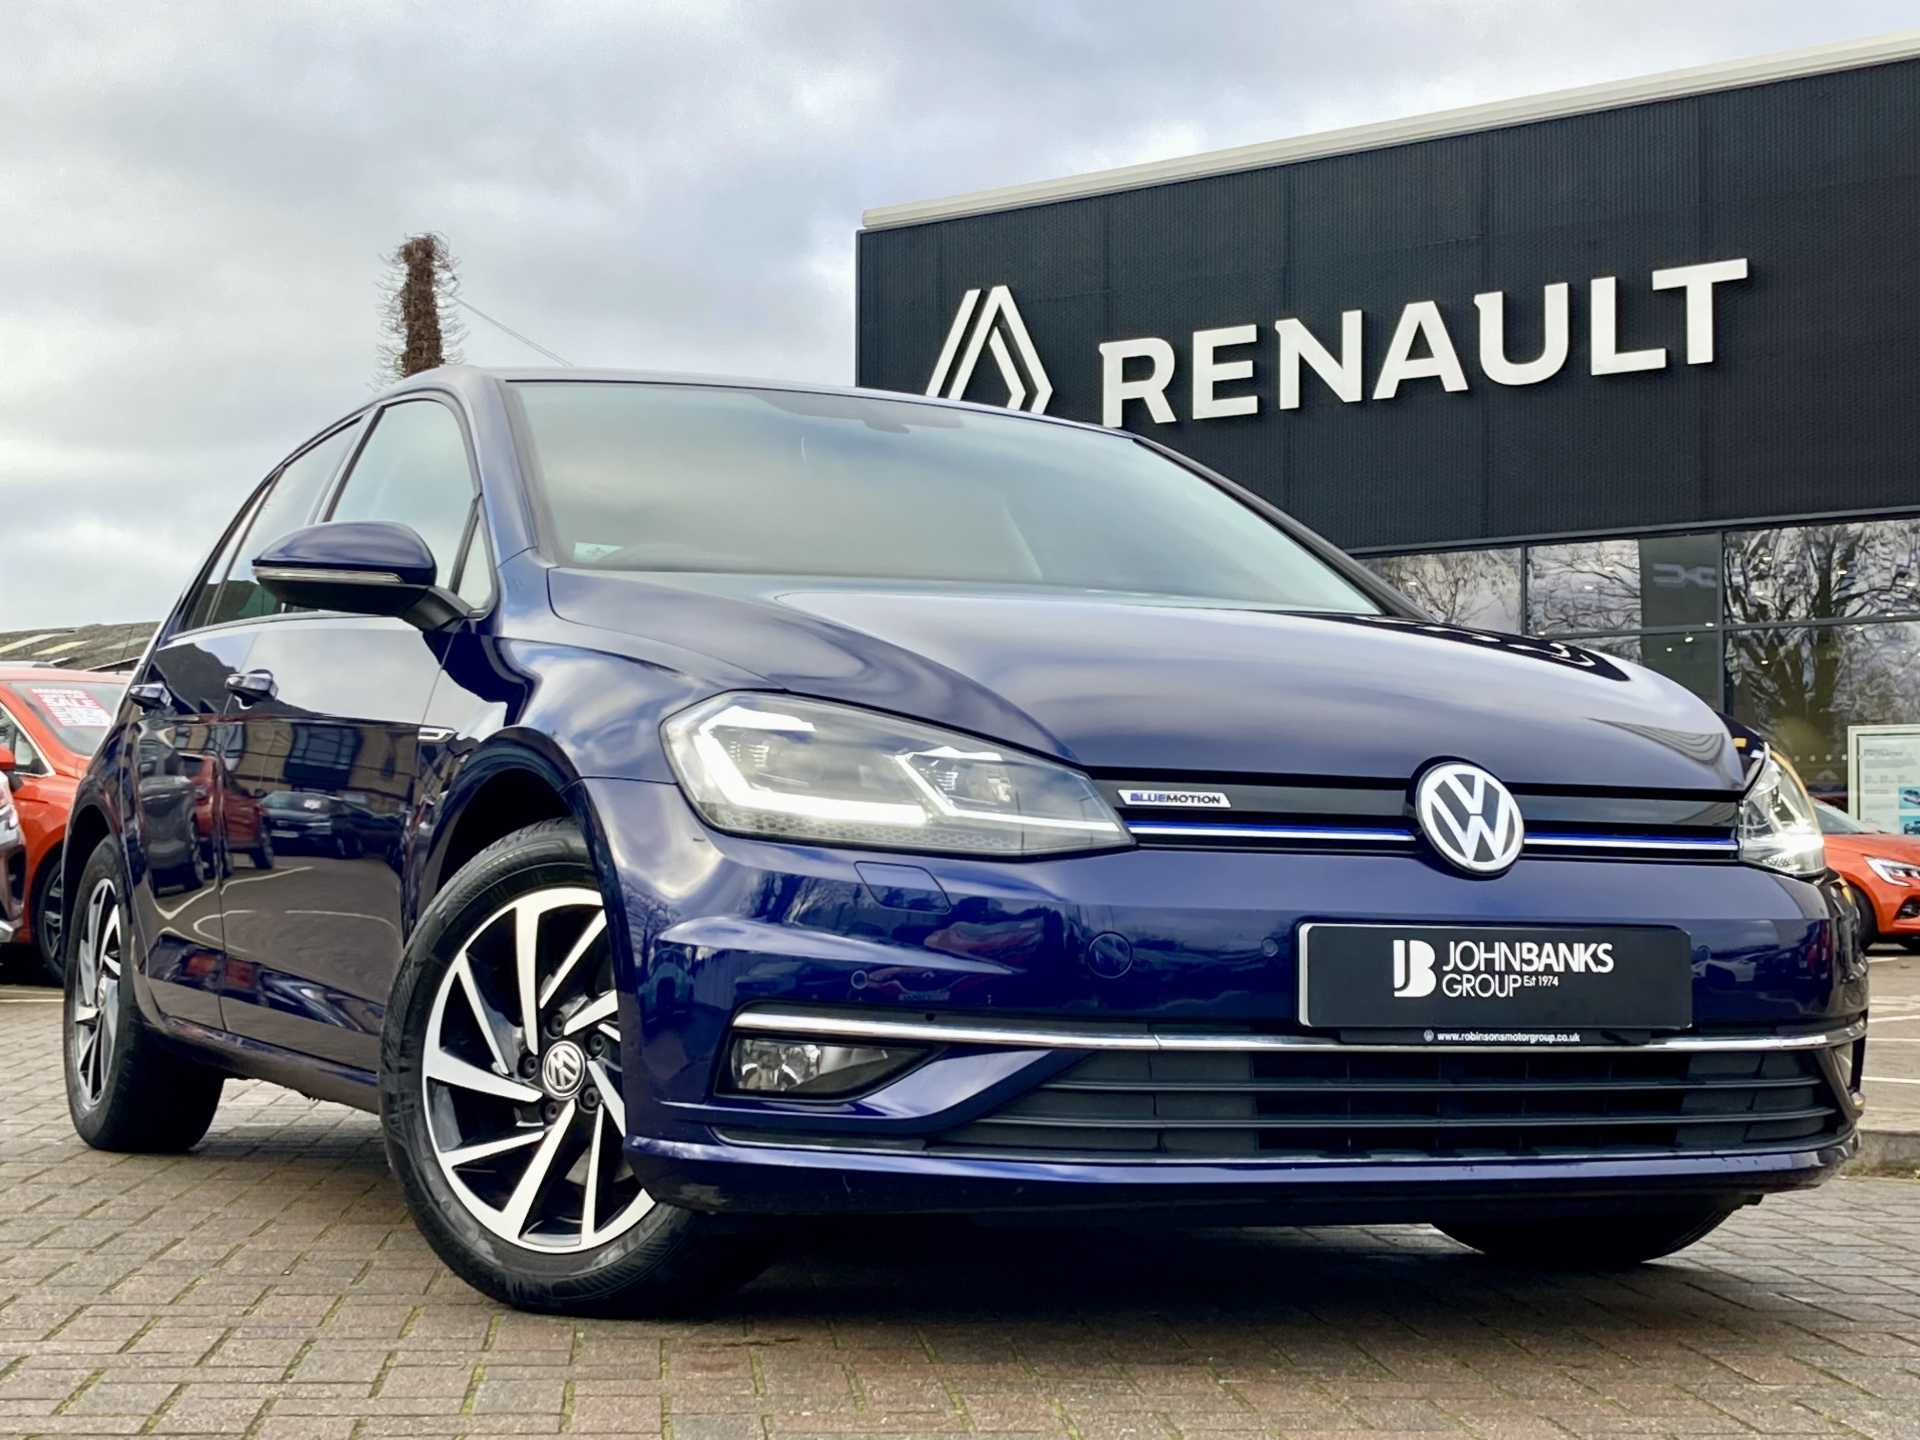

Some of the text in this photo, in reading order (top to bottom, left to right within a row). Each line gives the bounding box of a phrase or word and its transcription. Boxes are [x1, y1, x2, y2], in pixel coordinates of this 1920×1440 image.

[1098, 258, 1748, 428] RENAULT
[1130, 793, 1221, 804] BLUEMOTION
[1442, 974, 1559, 997] GROUP Est 1974
[1437, 1031, 1581, 1044] www.robinsonsmotorgroup.co.uk
